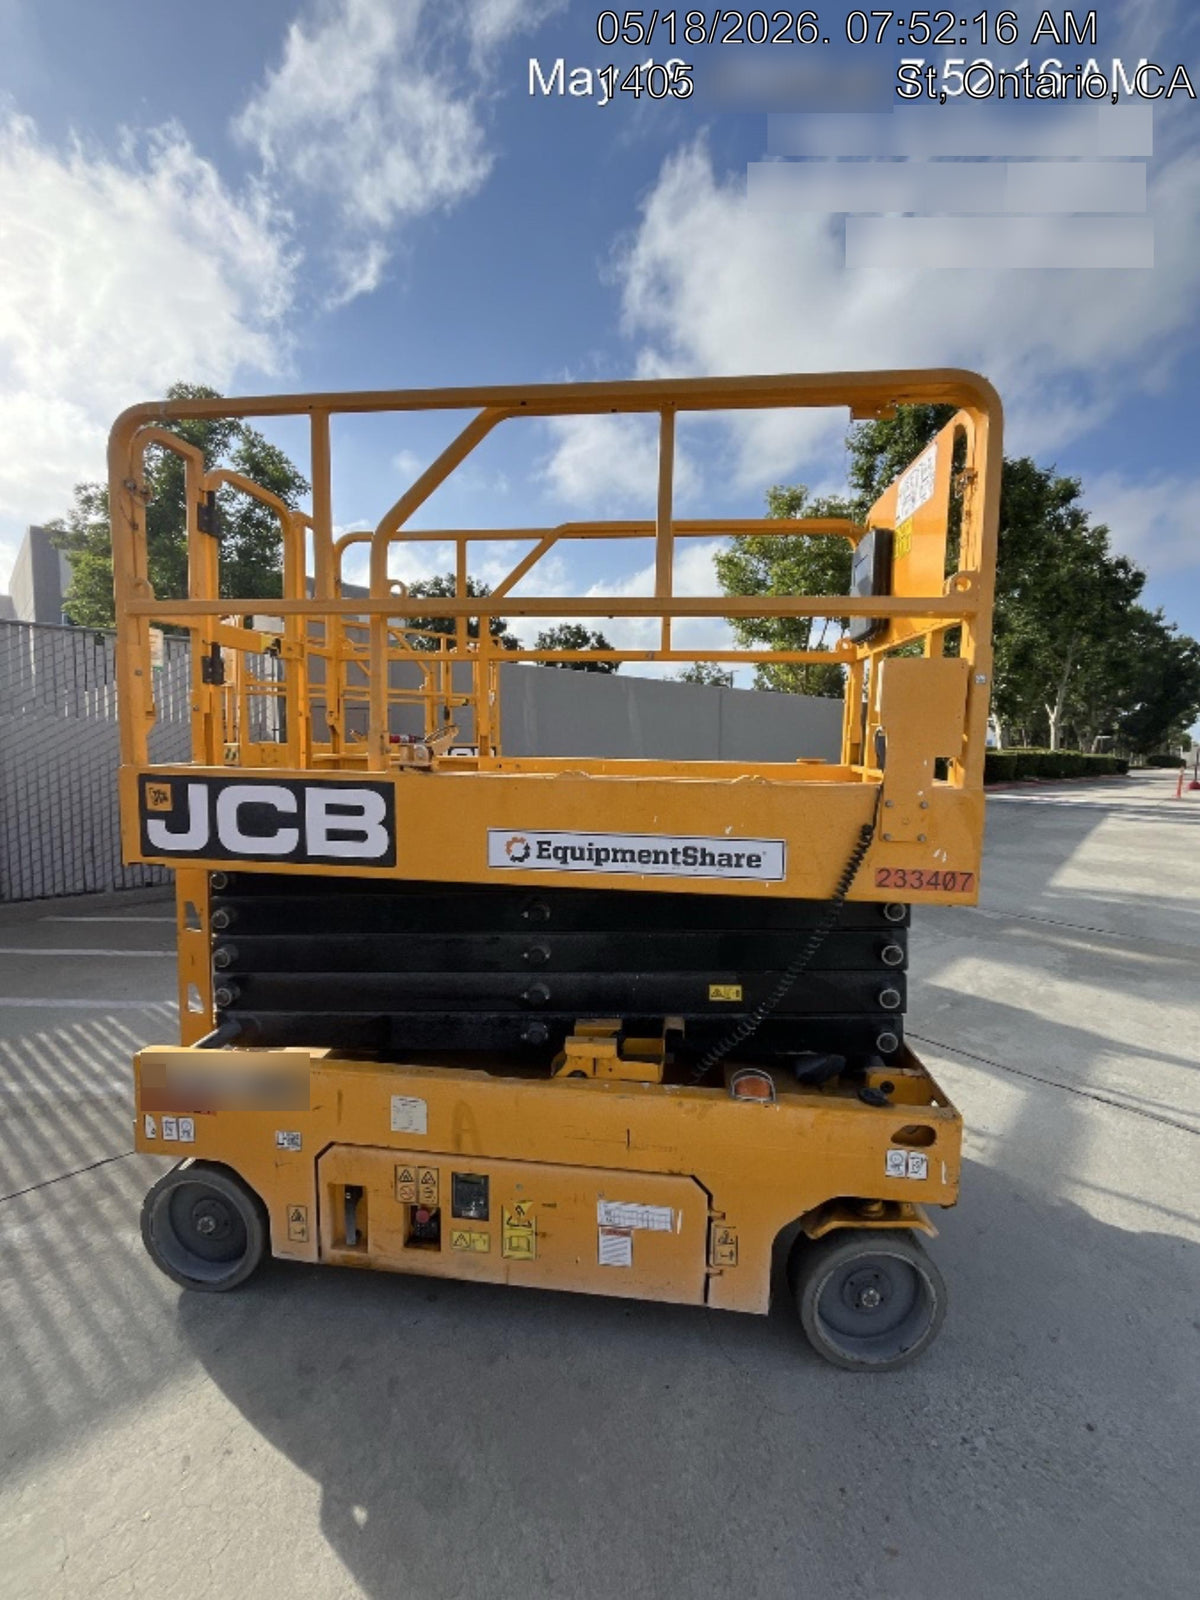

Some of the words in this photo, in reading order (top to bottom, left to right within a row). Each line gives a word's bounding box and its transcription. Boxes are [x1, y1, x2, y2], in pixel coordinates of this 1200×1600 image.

[147, 783, 389, 858] JCB
[536, 840, 763, 868] EquipmentShare
[875, 868, 974, 892] 233407
